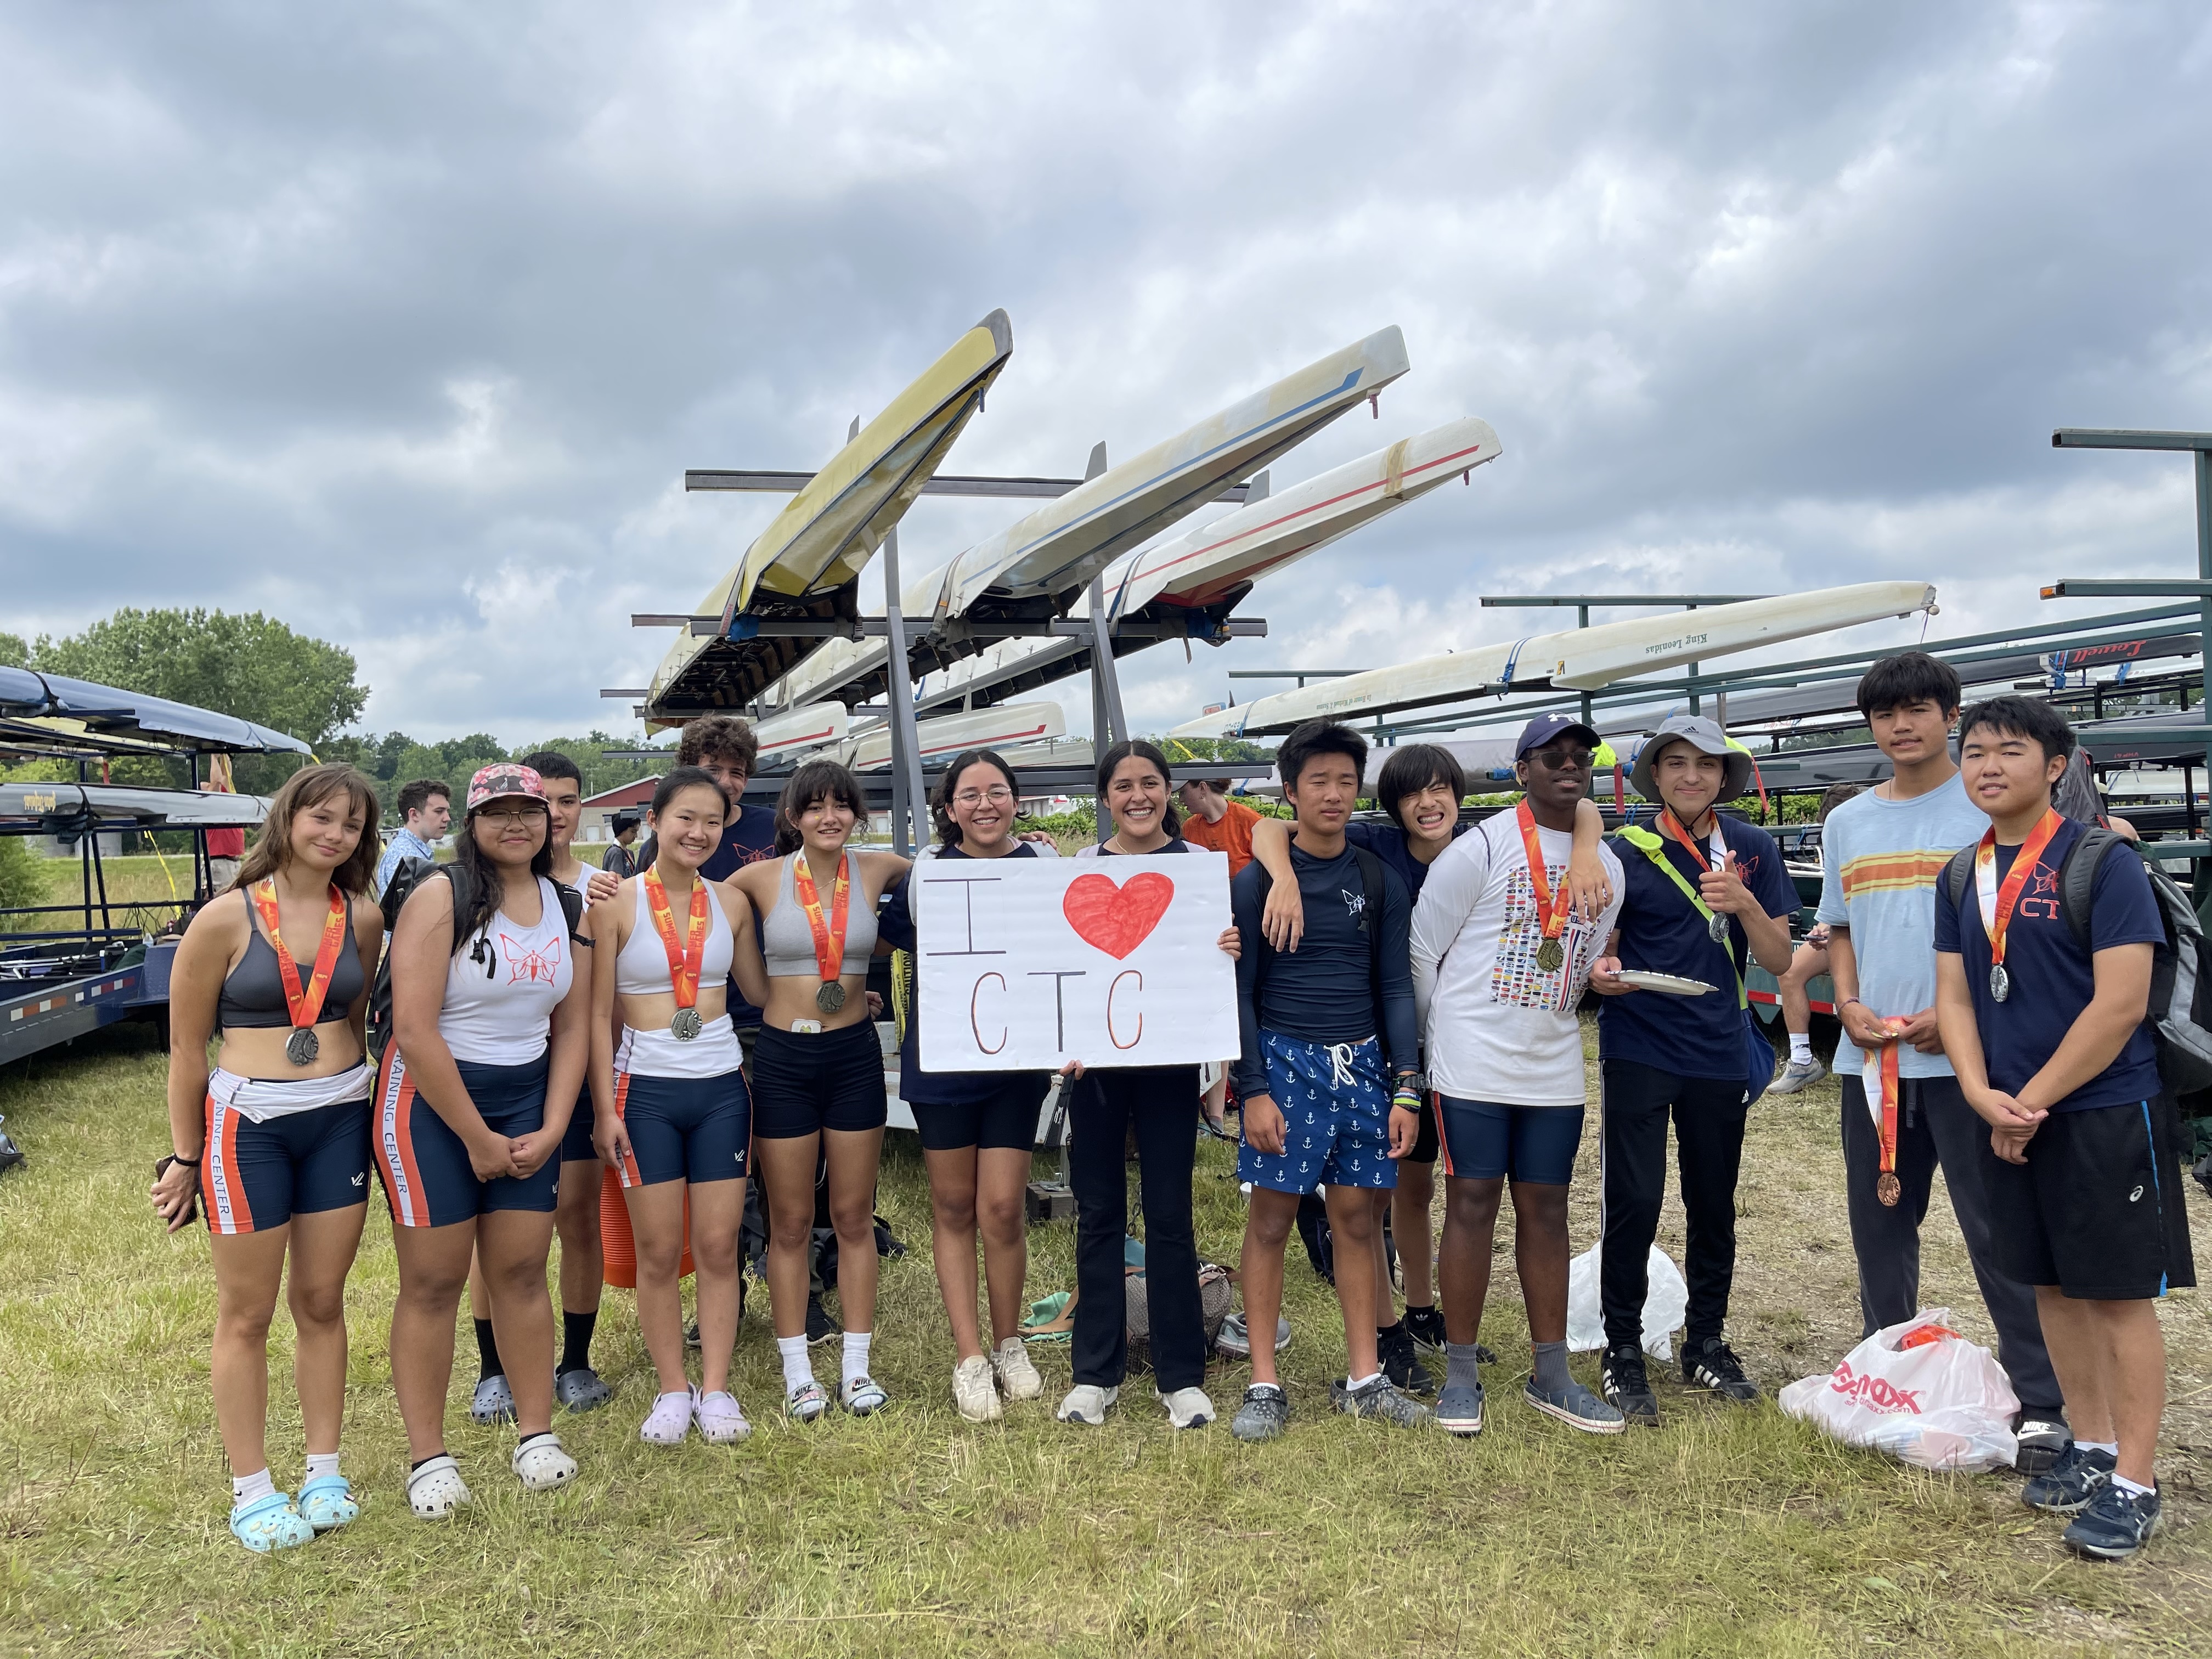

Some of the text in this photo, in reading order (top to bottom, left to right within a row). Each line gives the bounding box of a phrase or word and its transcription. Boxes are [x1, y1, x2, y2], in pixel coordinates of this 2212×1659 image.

[1645, 634, 1707, 654] King Leonidas
[2072, 640, 2146, 663] Lowell
[923, 878, 1006, 956] I
[2020, 898, 2061, 919] CT
[674, 1012, 685, 1031] MEIJER
[385, 1054, 407, 1194] RAINING CENTER
[212, 1155, 229, 1215] CENTER
[794, 1384, 813, 1398] NIKE
[2021, 1420, 2051, 1432] NIKE
